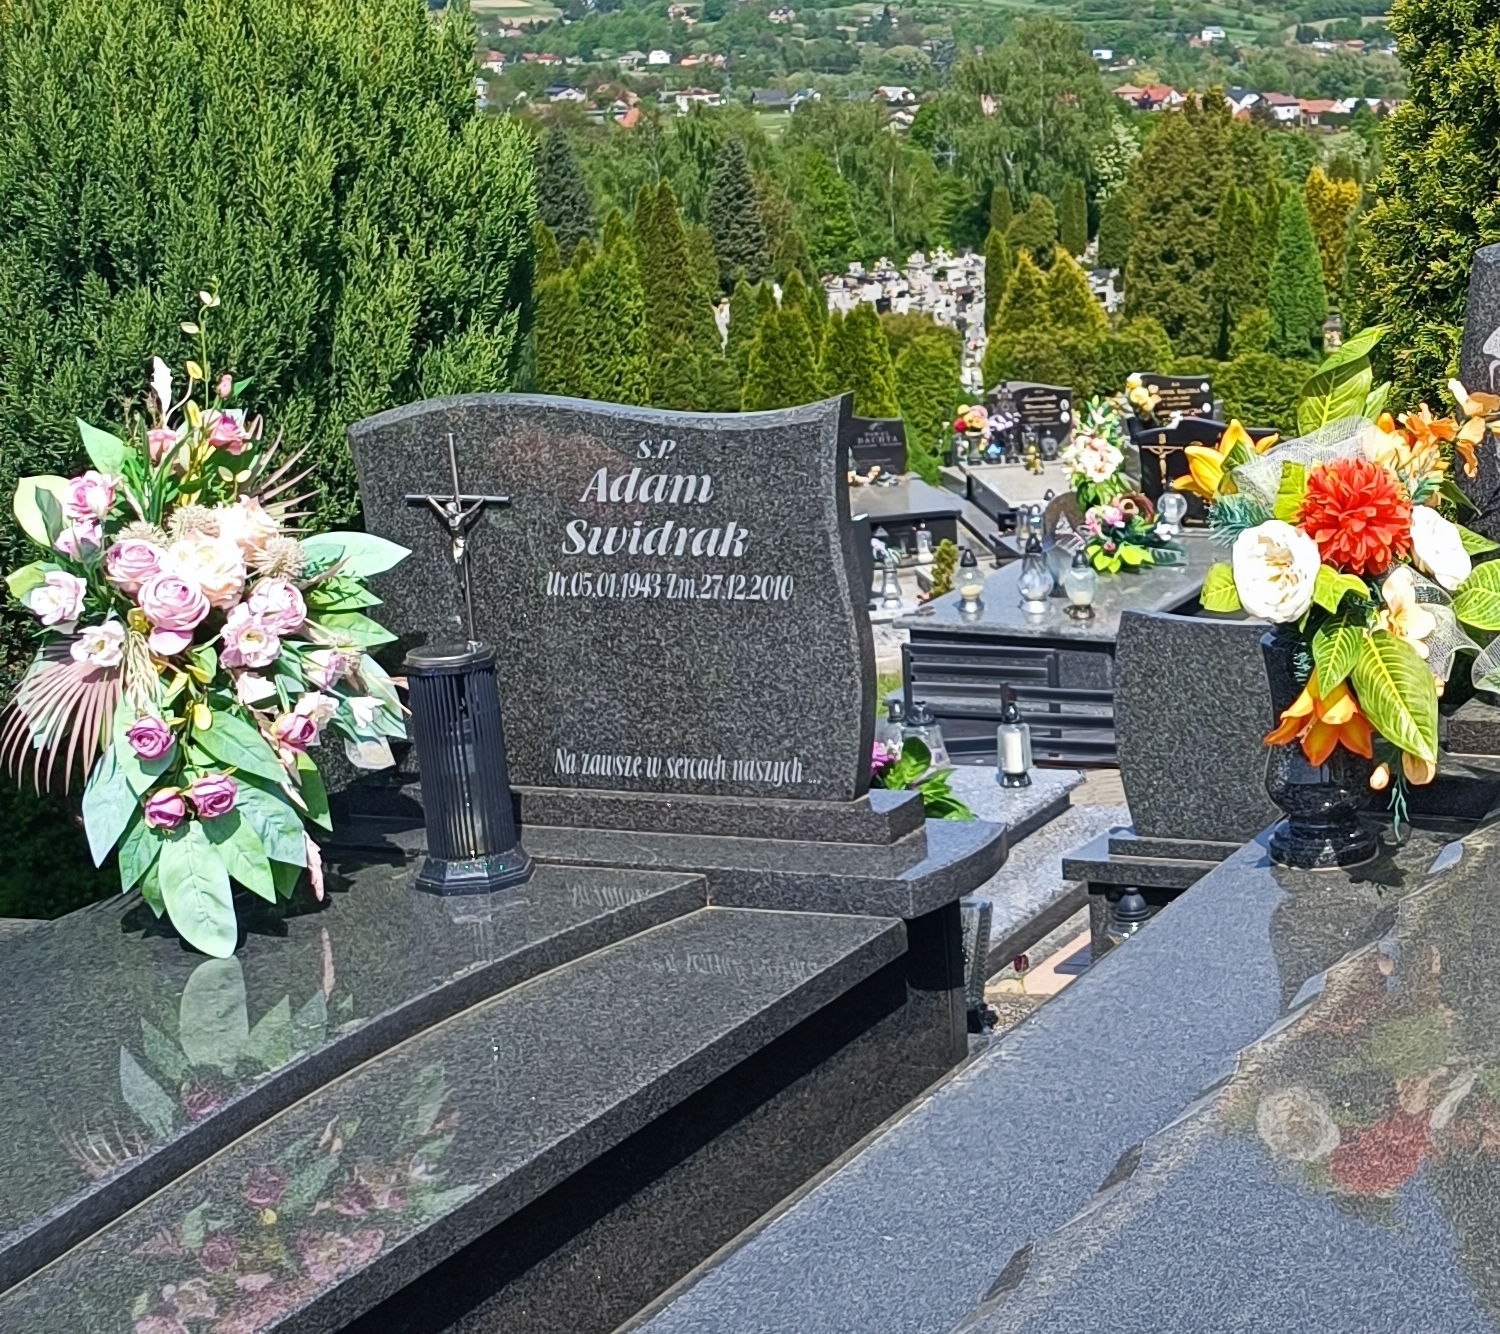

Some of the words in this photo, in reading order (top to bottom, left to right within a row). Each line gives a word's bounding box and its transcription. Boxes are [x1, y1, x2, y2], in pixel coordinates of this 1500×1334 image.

[578, 467, 714, 504] Adam
[554, 748, 577, 775] Na
[580, 753, 642, 778] zawsze
[645, 756, 662, 779] w
[665, 753, 727, 780] sercach
[732, 756, 802, 788] naszych
